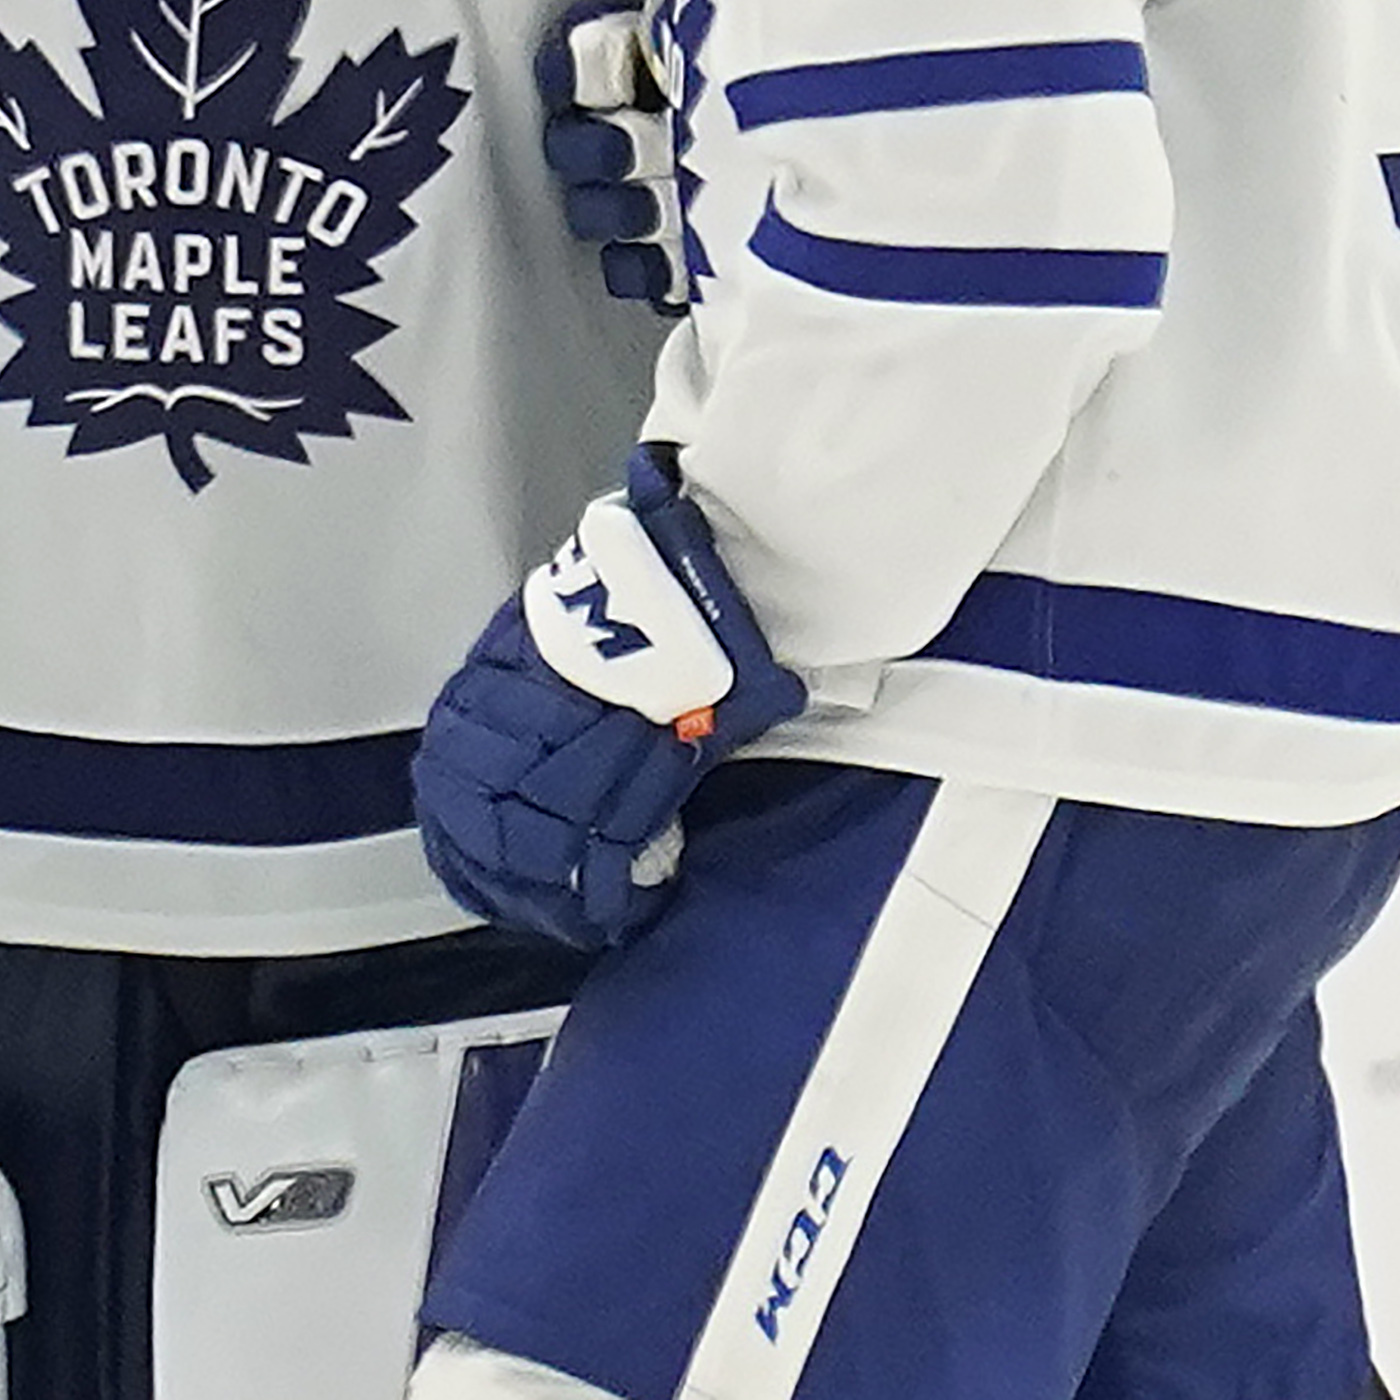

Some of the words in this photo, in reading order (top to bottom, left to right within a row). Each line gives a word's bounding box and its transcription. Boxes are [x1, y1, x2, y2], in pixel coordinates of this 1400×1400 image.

[12, 138, 369, 248] TORONTO
[69, 227, 307, 296] MAPLE
[67, 300, 305, 367] LEAFS
[755, 1146, 854, 1344] CCM
